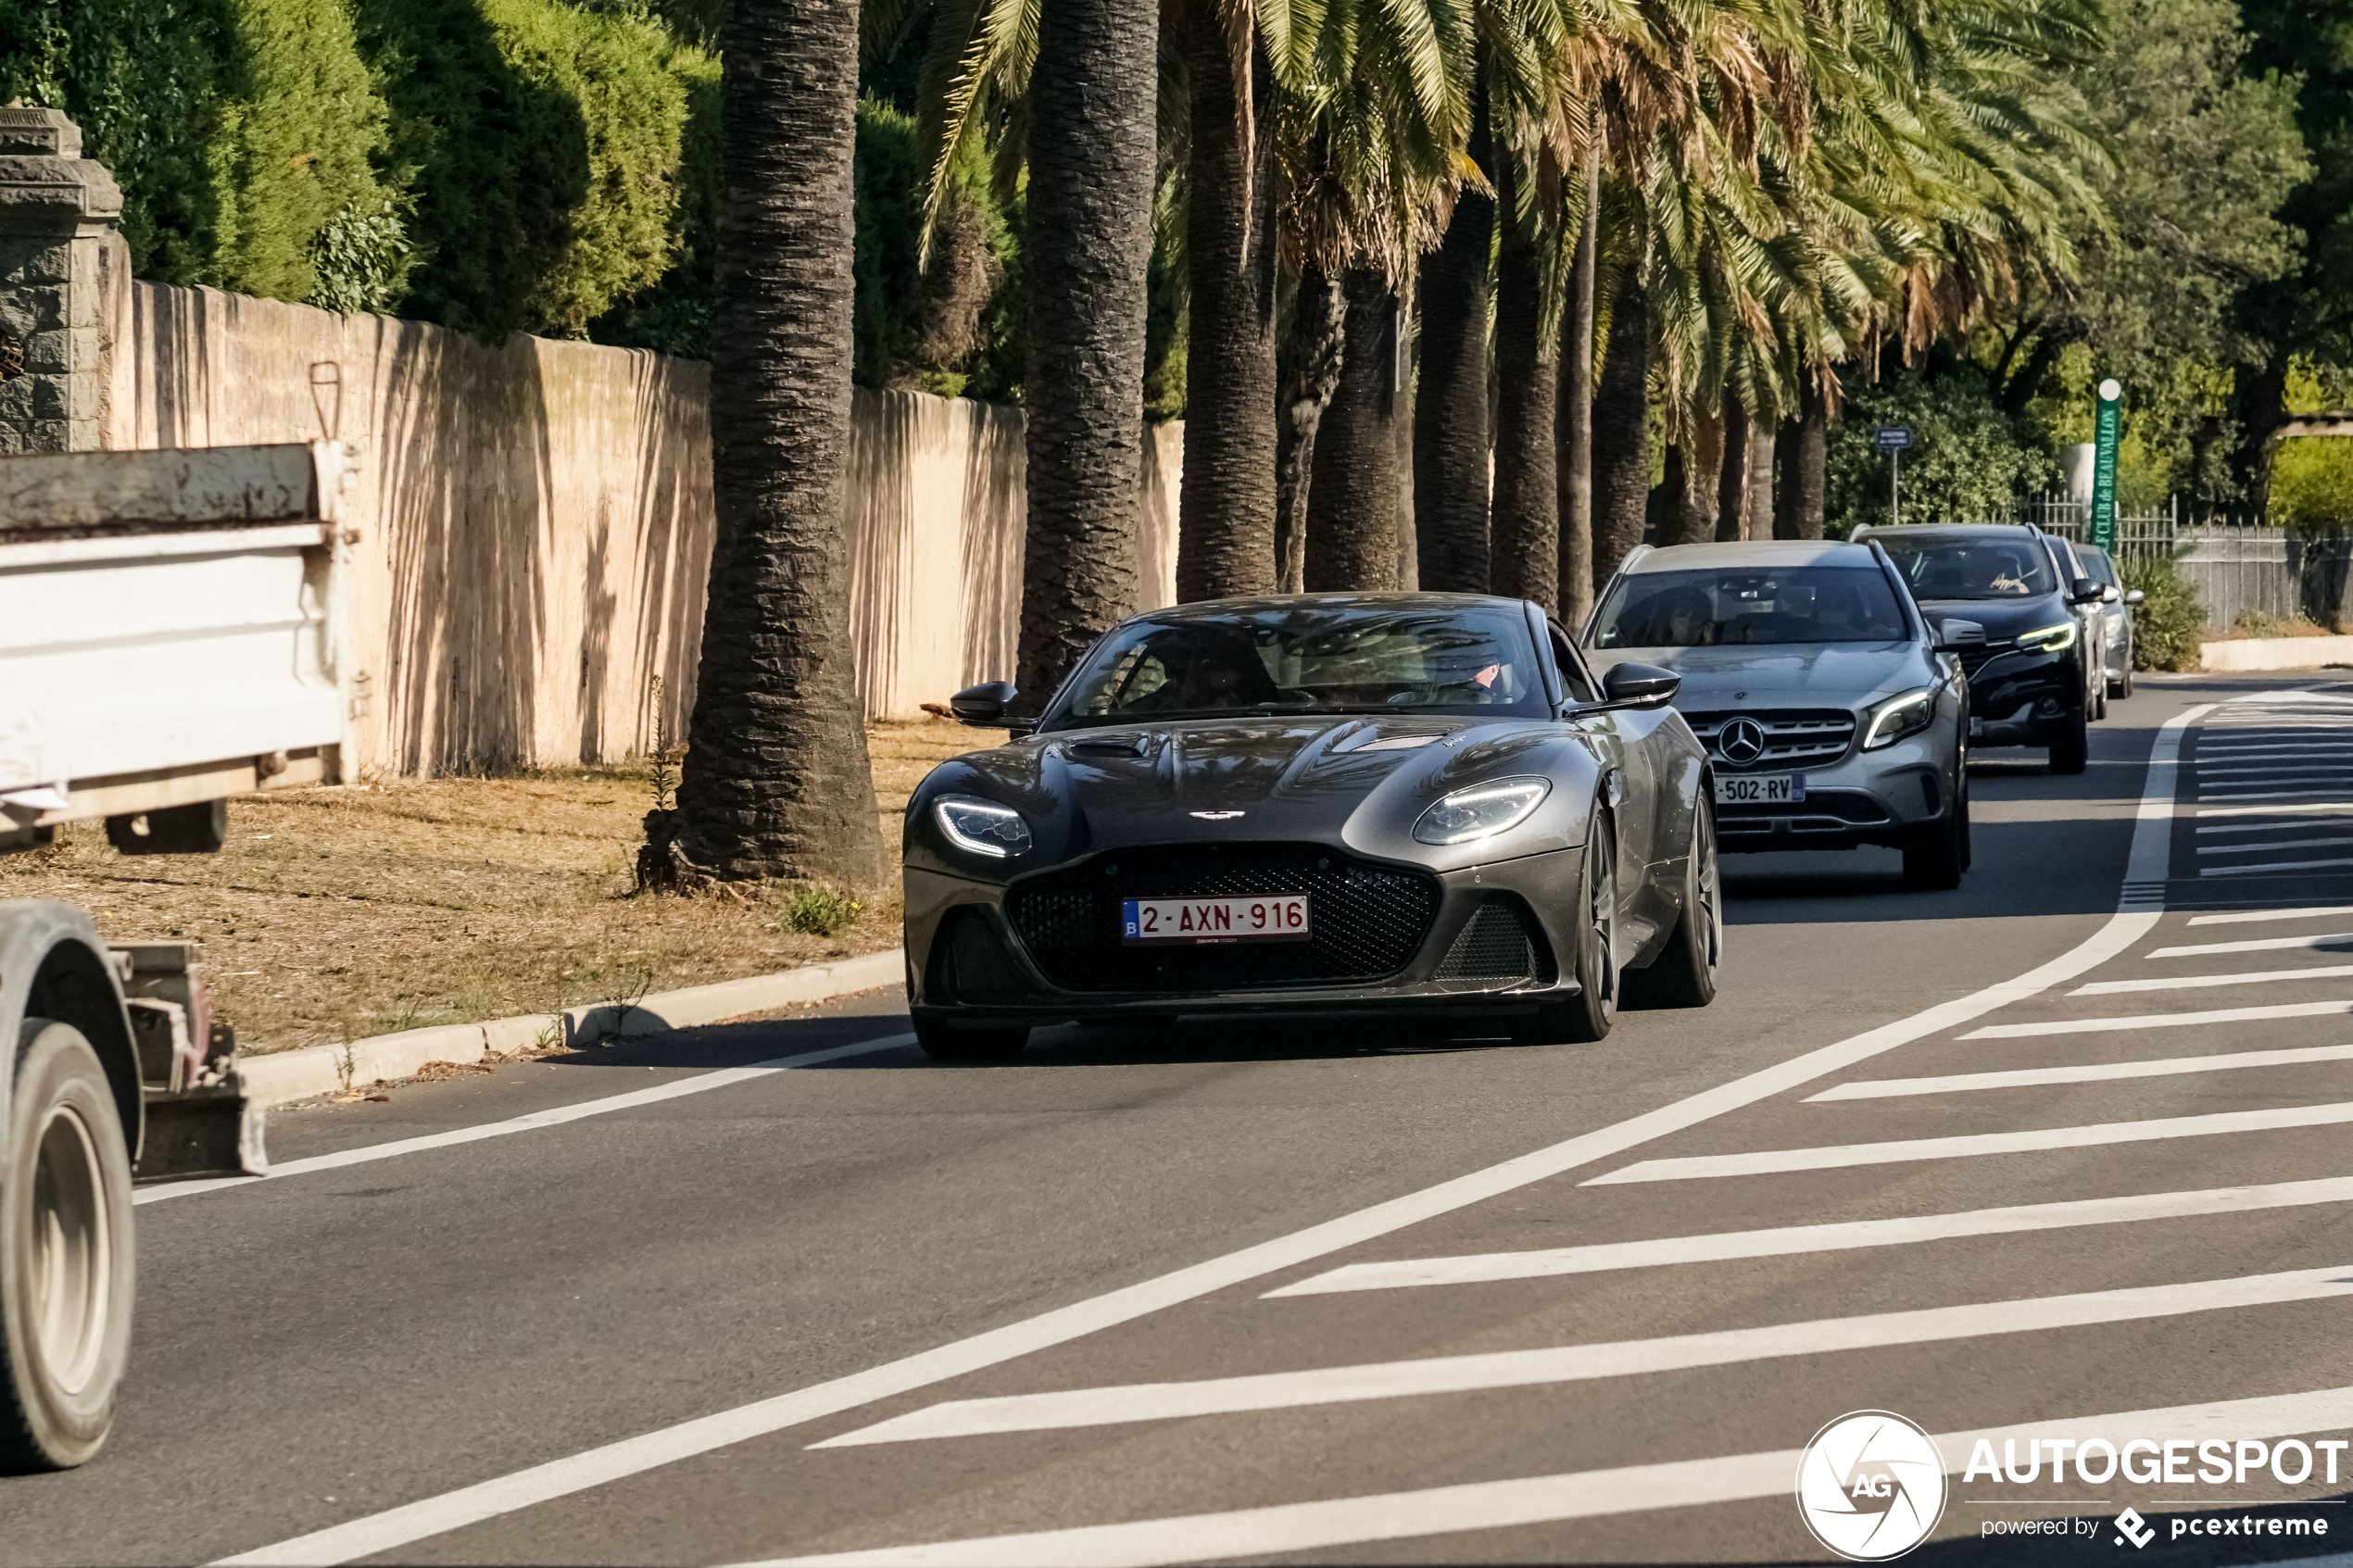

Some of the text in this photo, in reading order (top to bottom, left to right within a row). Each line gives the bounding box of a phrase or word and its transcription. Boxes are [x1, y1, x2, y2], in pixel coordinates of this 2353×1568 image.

[2098, 409, 2115, 486] BEAUVALLON
[2098, 488, 2112, 501] de
[2096, 503, 2111, 533] CLUB
[1126, 922, 1137, 935] B
[1142, 901, 1303, 933] 2-AXN-916
